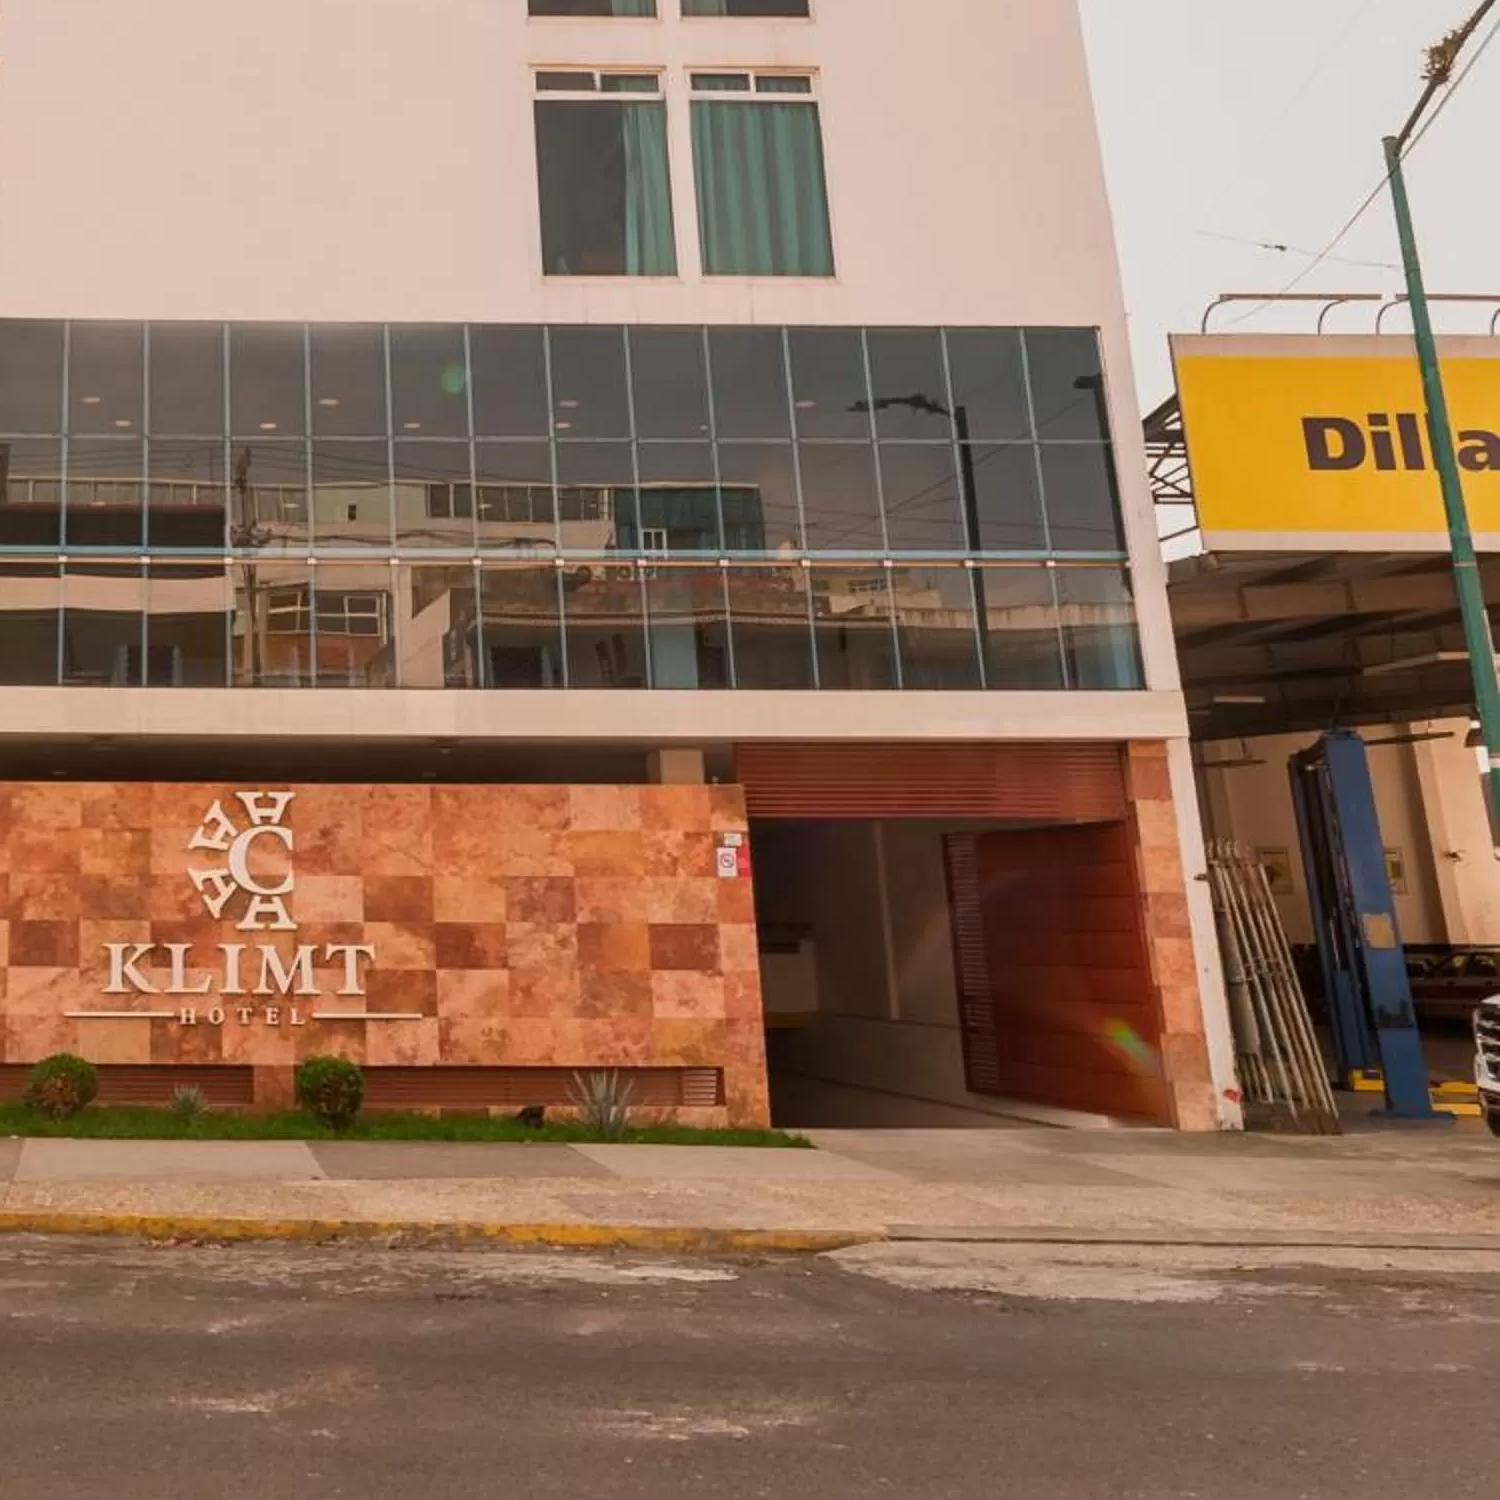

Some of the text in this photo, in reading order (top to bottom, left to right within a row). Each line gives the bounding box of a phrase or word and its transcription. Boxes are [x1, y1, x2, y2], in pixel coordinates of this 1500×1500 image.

[1301, 412, 1500, 472] Dila
[102, 942, 376, 996] KLIMT
[179, 1007, 306, 1026] HOTEL
